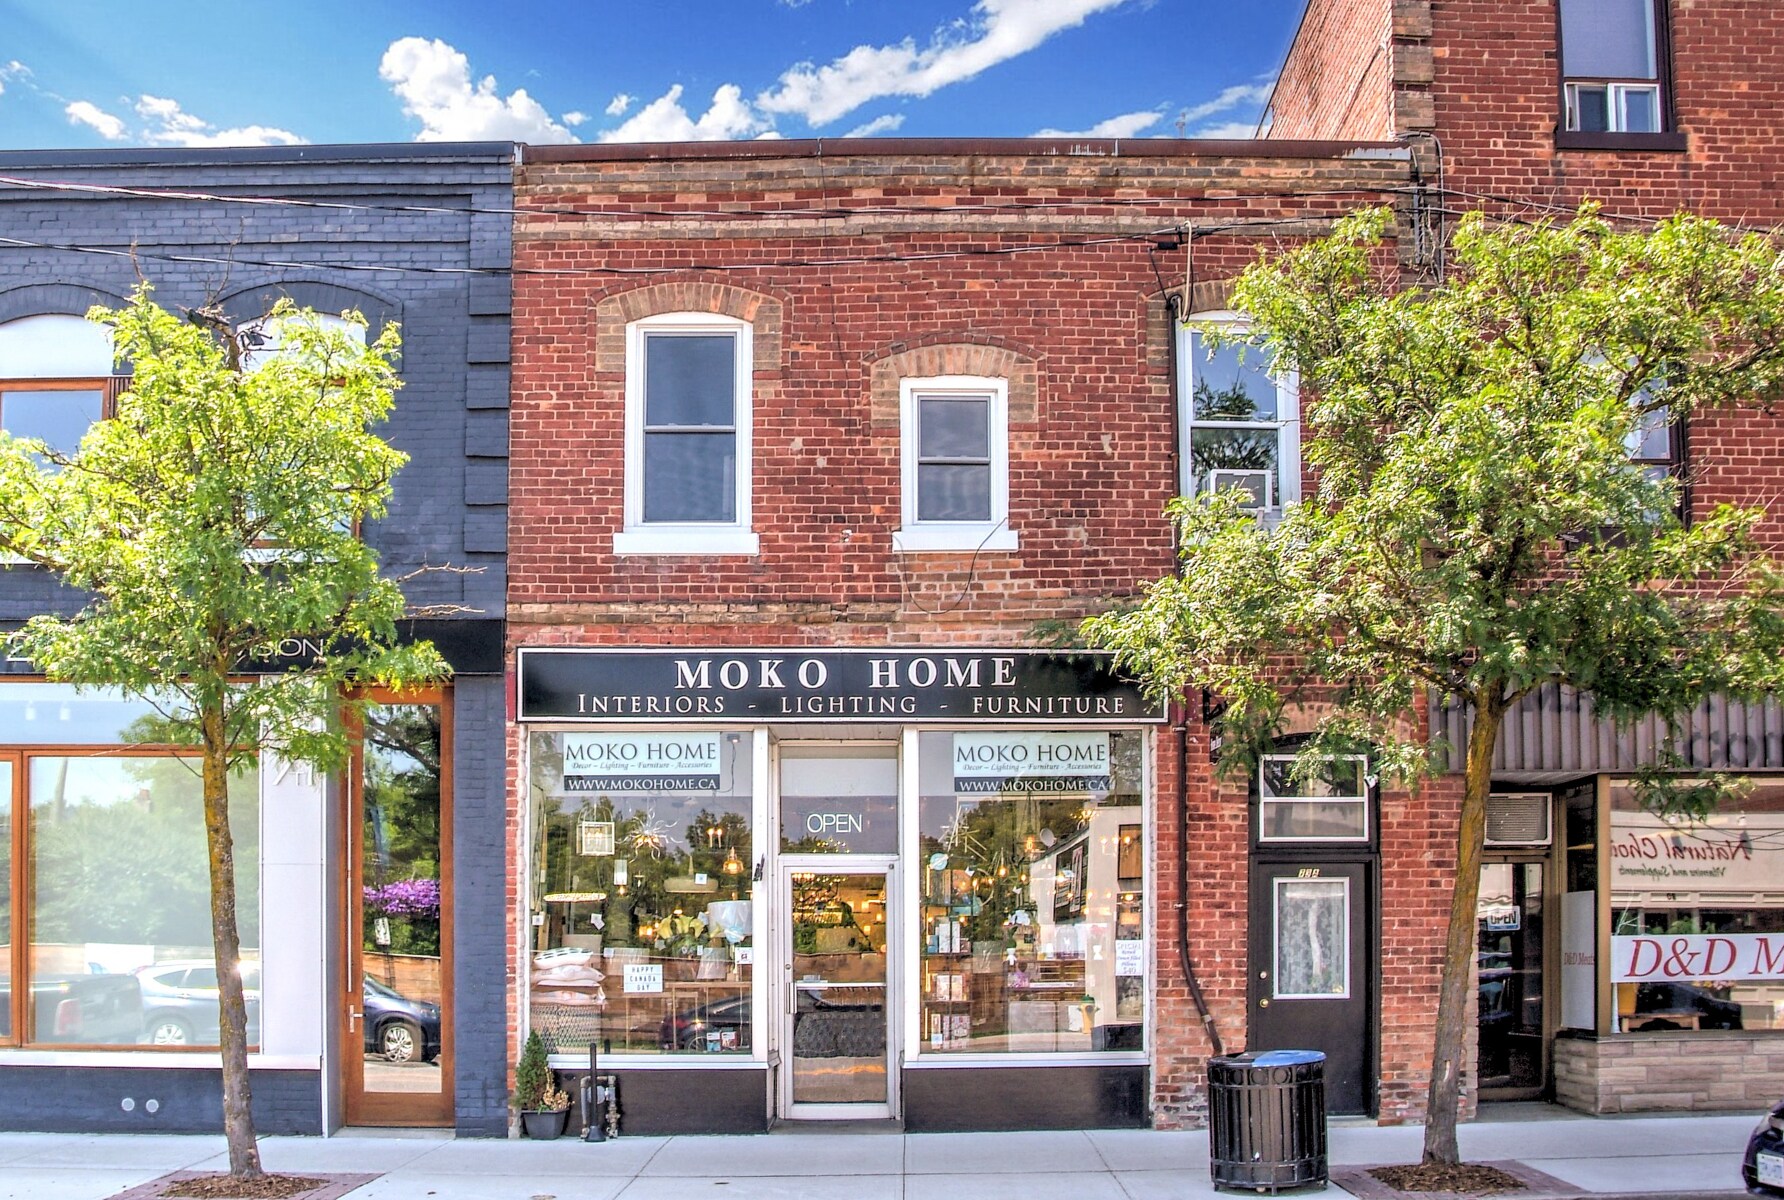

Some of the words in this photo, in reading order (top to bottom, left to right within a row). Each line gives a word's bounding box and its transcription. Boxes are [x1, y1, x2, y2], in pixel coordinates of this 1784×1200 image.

[674, 659, 828, 690] MOKO
[868, 657, 1017, 688] HOME
[578, 694, 724, 713] INTERIORS
[781, 696, 916, 713] LIGHTING
[973, 696, 1124, 714] FURNITURE
[565, 743, 638, 760] MOKO
[647, 742, 717, 760] HOME
[956, 744, 1028, 762] MOKO
[1037, 744, 1106, 761] HOME
[599, 761, 629, 770] Lighting
[990, 763, 1020, 772] Lighting
[1027, 763, 1060, 771] Furniture
[568, 778, 717, 790] WWW.MOKOHOME.CA
[959, 780, 1107, 792] WWW.MOKOHOME.CA
[807, 813, 863, 833] OPEN
[1623, 938, 1737, 977] D&D
